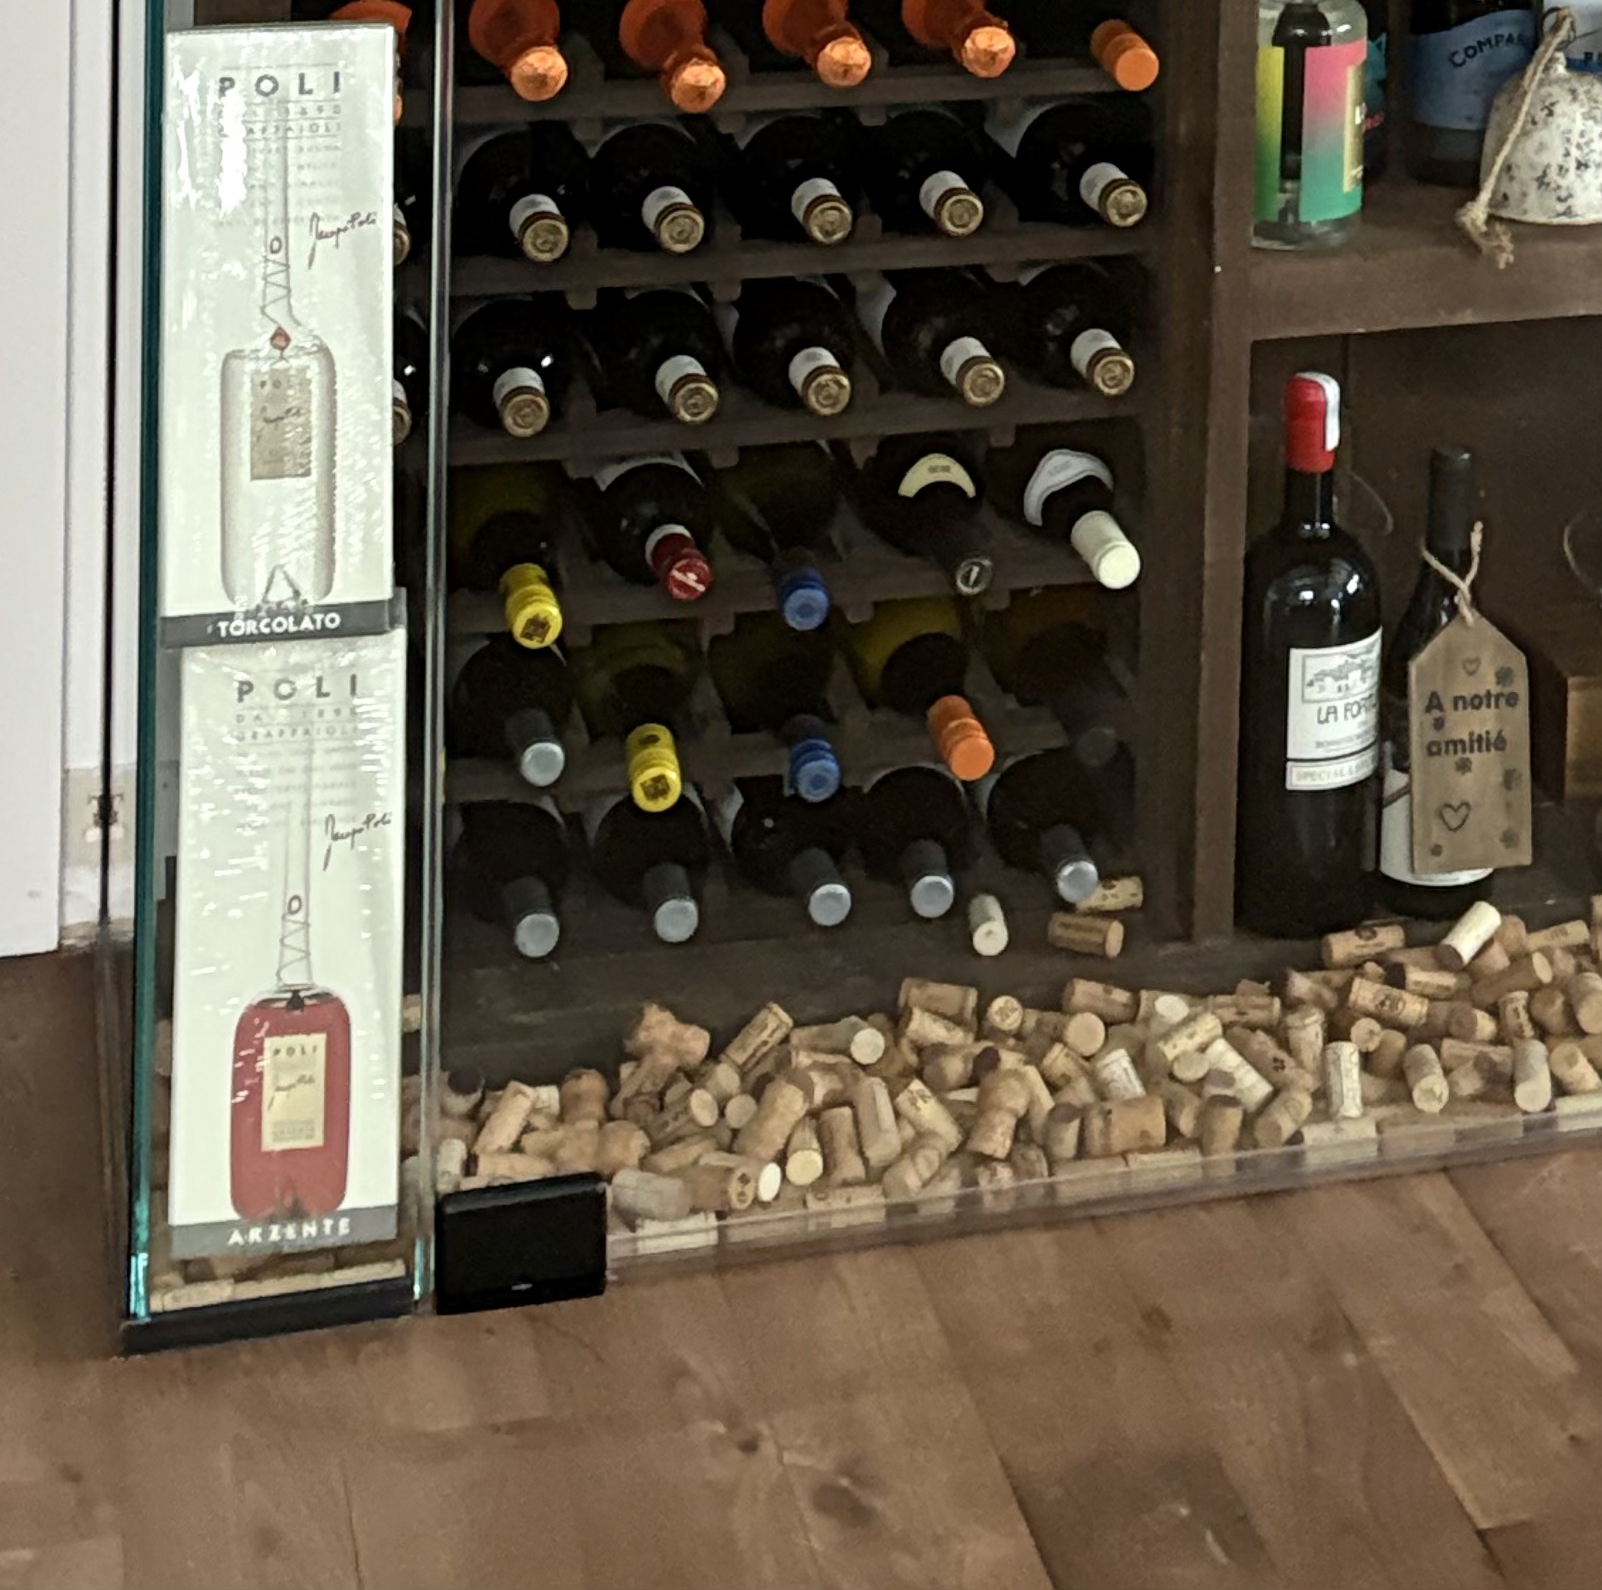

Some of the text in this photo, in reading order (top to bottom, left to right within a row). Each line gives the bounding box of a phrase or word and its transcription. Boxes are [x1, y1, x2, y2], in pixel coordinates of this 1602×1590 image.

[1449, 32, 1533, 69] COMPA
[218, 71, 341, 99] POLI
[217, 612, 342, 638] TORCOLATO
[236, 674, 358, 703] POLI
[1425, 688, 1520, 714] A notre
[1316, 703, 1339, 725] LA
[1426, 728, 1508, 757] amitié
[227, 1217, 351, 1246] ARZENTE
